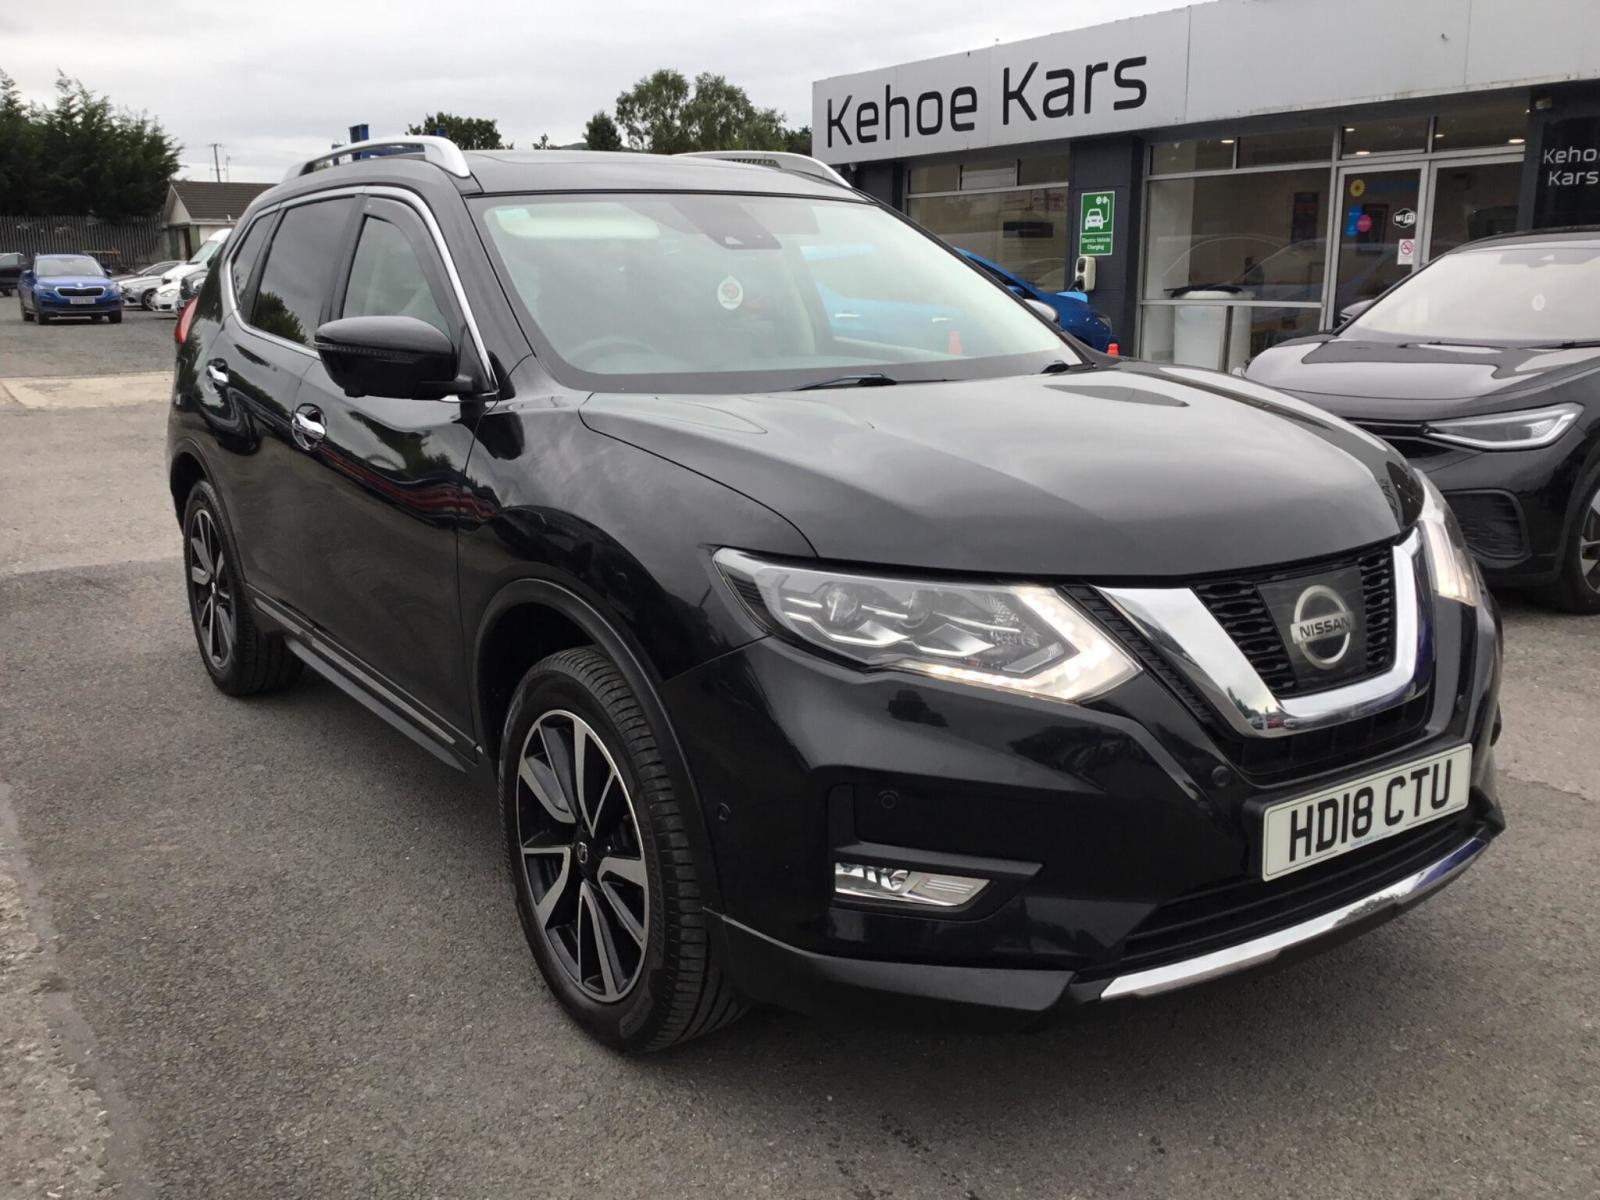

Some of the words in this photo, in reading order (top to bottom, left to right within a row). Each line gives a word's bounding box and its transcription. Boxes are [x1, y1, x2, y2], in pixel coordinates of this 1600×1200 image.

[827, 84, 978, 148] Kehoe
[1003, 56, 1147, 125] Kars
[1543, 146, 1600, 164] Keho
[1548, 170, 1599, 186] Kars
[1299, 616, 1351, 638] NISSAN
[1289, 786, 1374, 863] HD18
[1384, 759, 1453, 827] CTU
